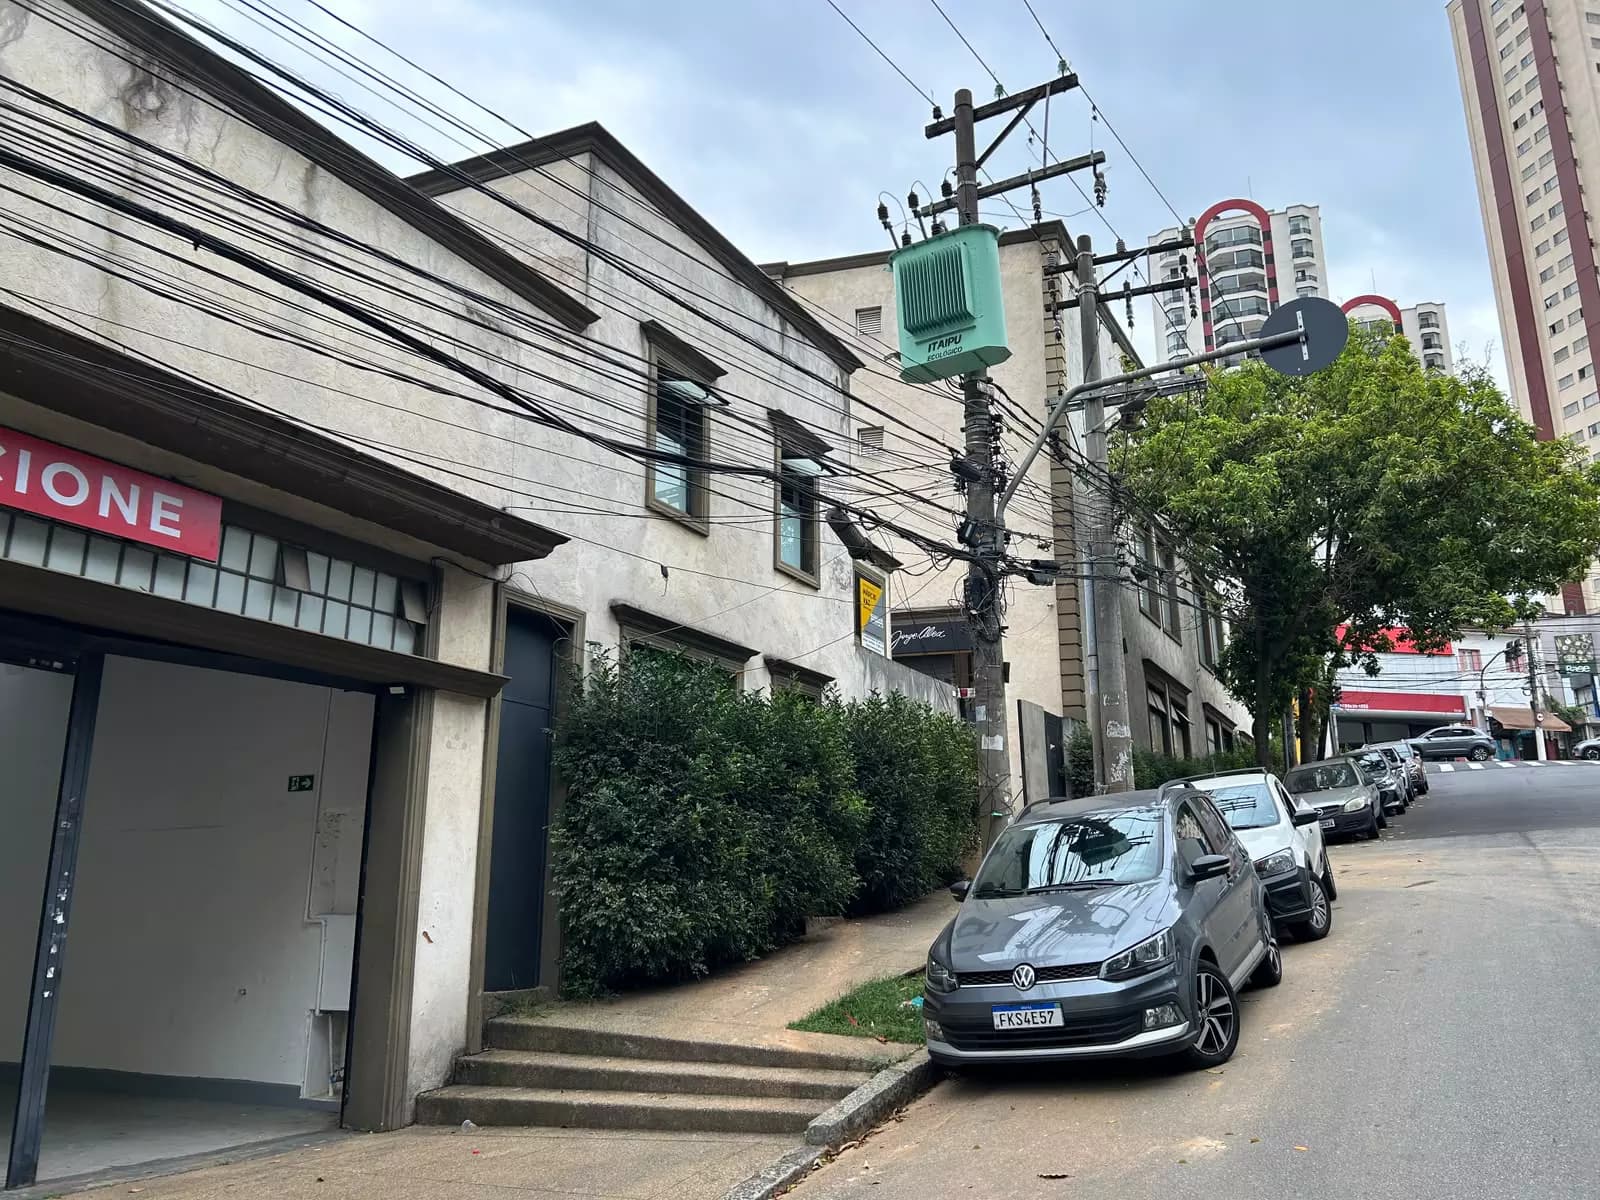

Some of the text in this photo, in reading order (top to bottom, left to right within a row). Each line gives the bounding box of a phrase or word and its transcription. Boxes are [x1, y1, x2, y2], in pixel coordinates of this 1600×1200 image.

[928, 334, 962, 353] ITAIPU
[0, 444, 184, 538] IONE
[999, 1011, 1054, 1027] FKS4E57
